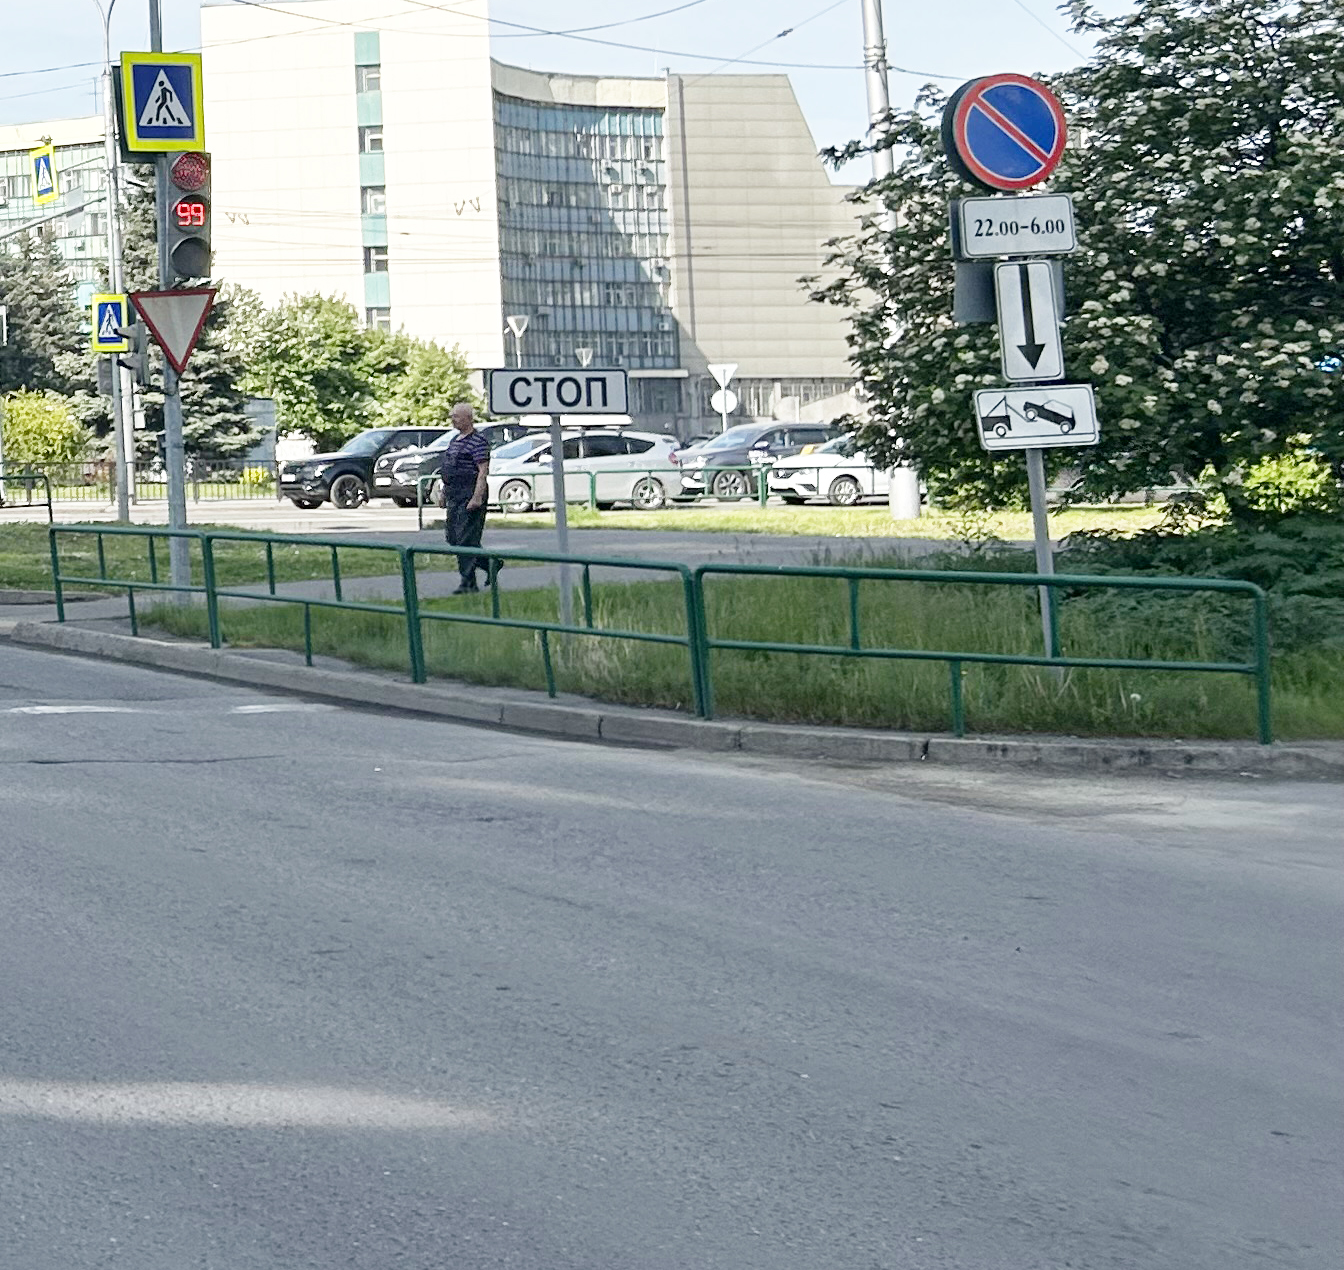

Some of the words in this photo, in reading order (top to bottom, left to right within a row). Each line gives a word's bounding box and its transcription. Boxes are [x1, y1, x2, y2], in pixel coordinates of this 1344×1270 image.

[176, 203, 205, 226] 99
[974, 216, 1065, 237] 22.00-6.00
[509, 377, 607, 407] СТОП
